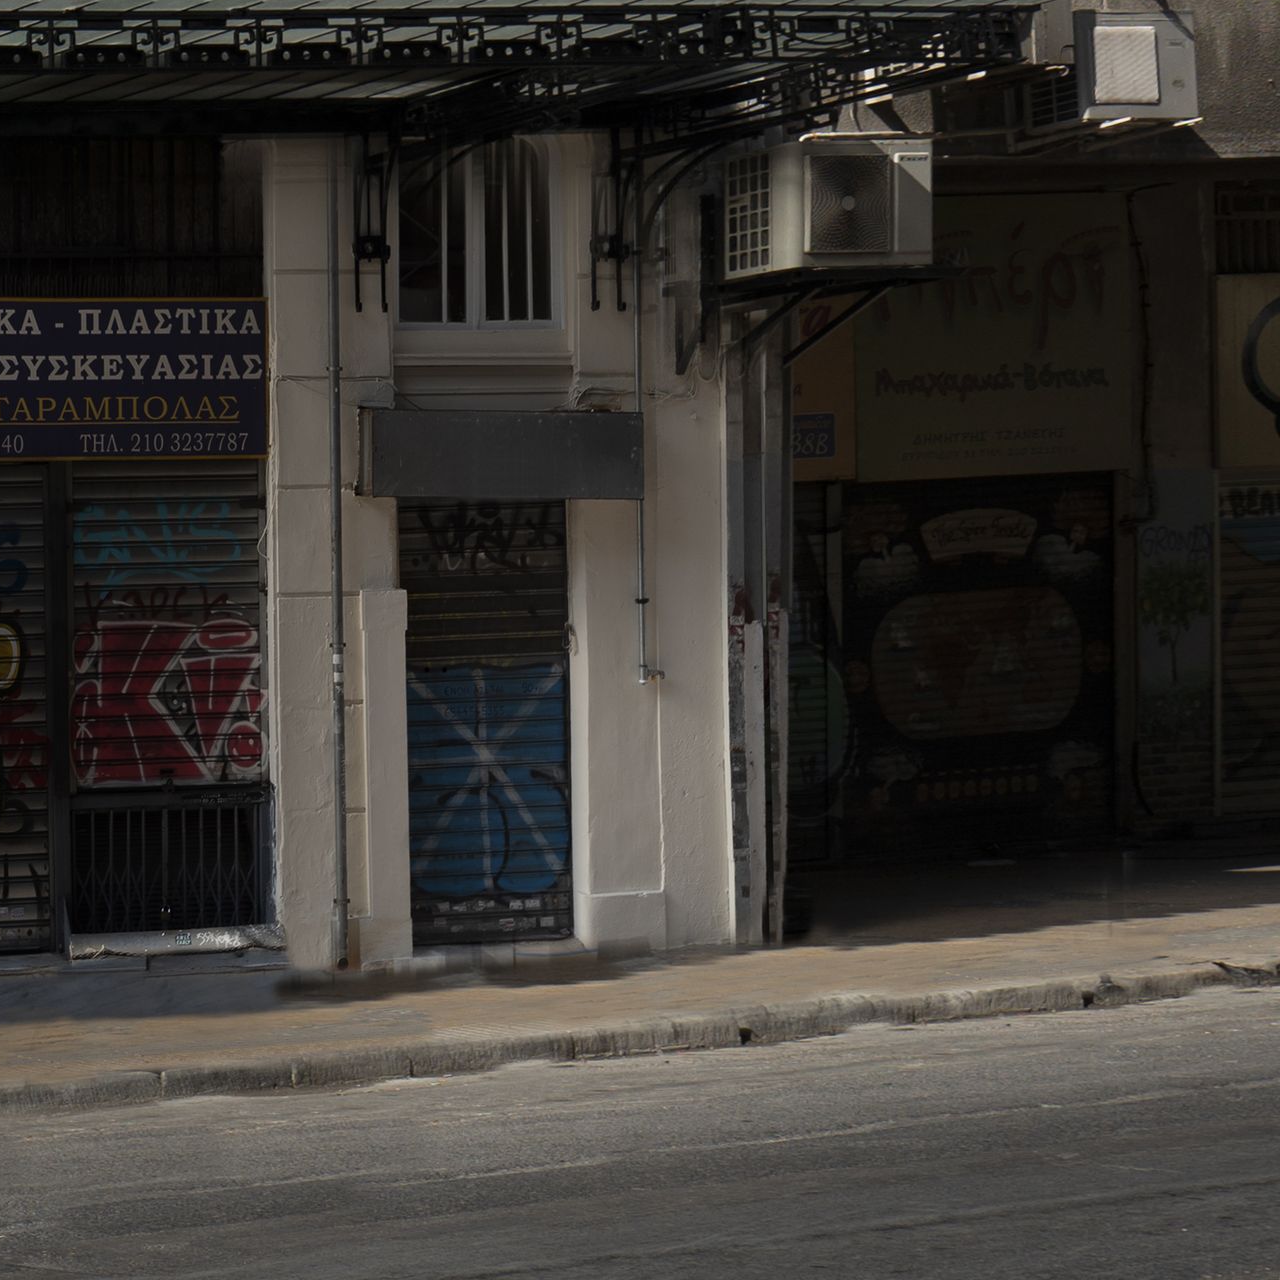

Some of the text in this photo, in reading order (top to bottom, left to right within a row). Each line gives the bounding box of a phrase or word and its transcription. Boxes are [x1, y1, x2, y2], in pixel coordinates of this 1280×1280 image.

[78, 308, 261, 335] ΠΛΑΣΤΙΚΑ
[1, 434, 24, 454] 40
[79, 433, 124, 454] ΤΗΛ.
[130, 433, 164, 453] 210
[170, 432, 249, 452] 3237787
